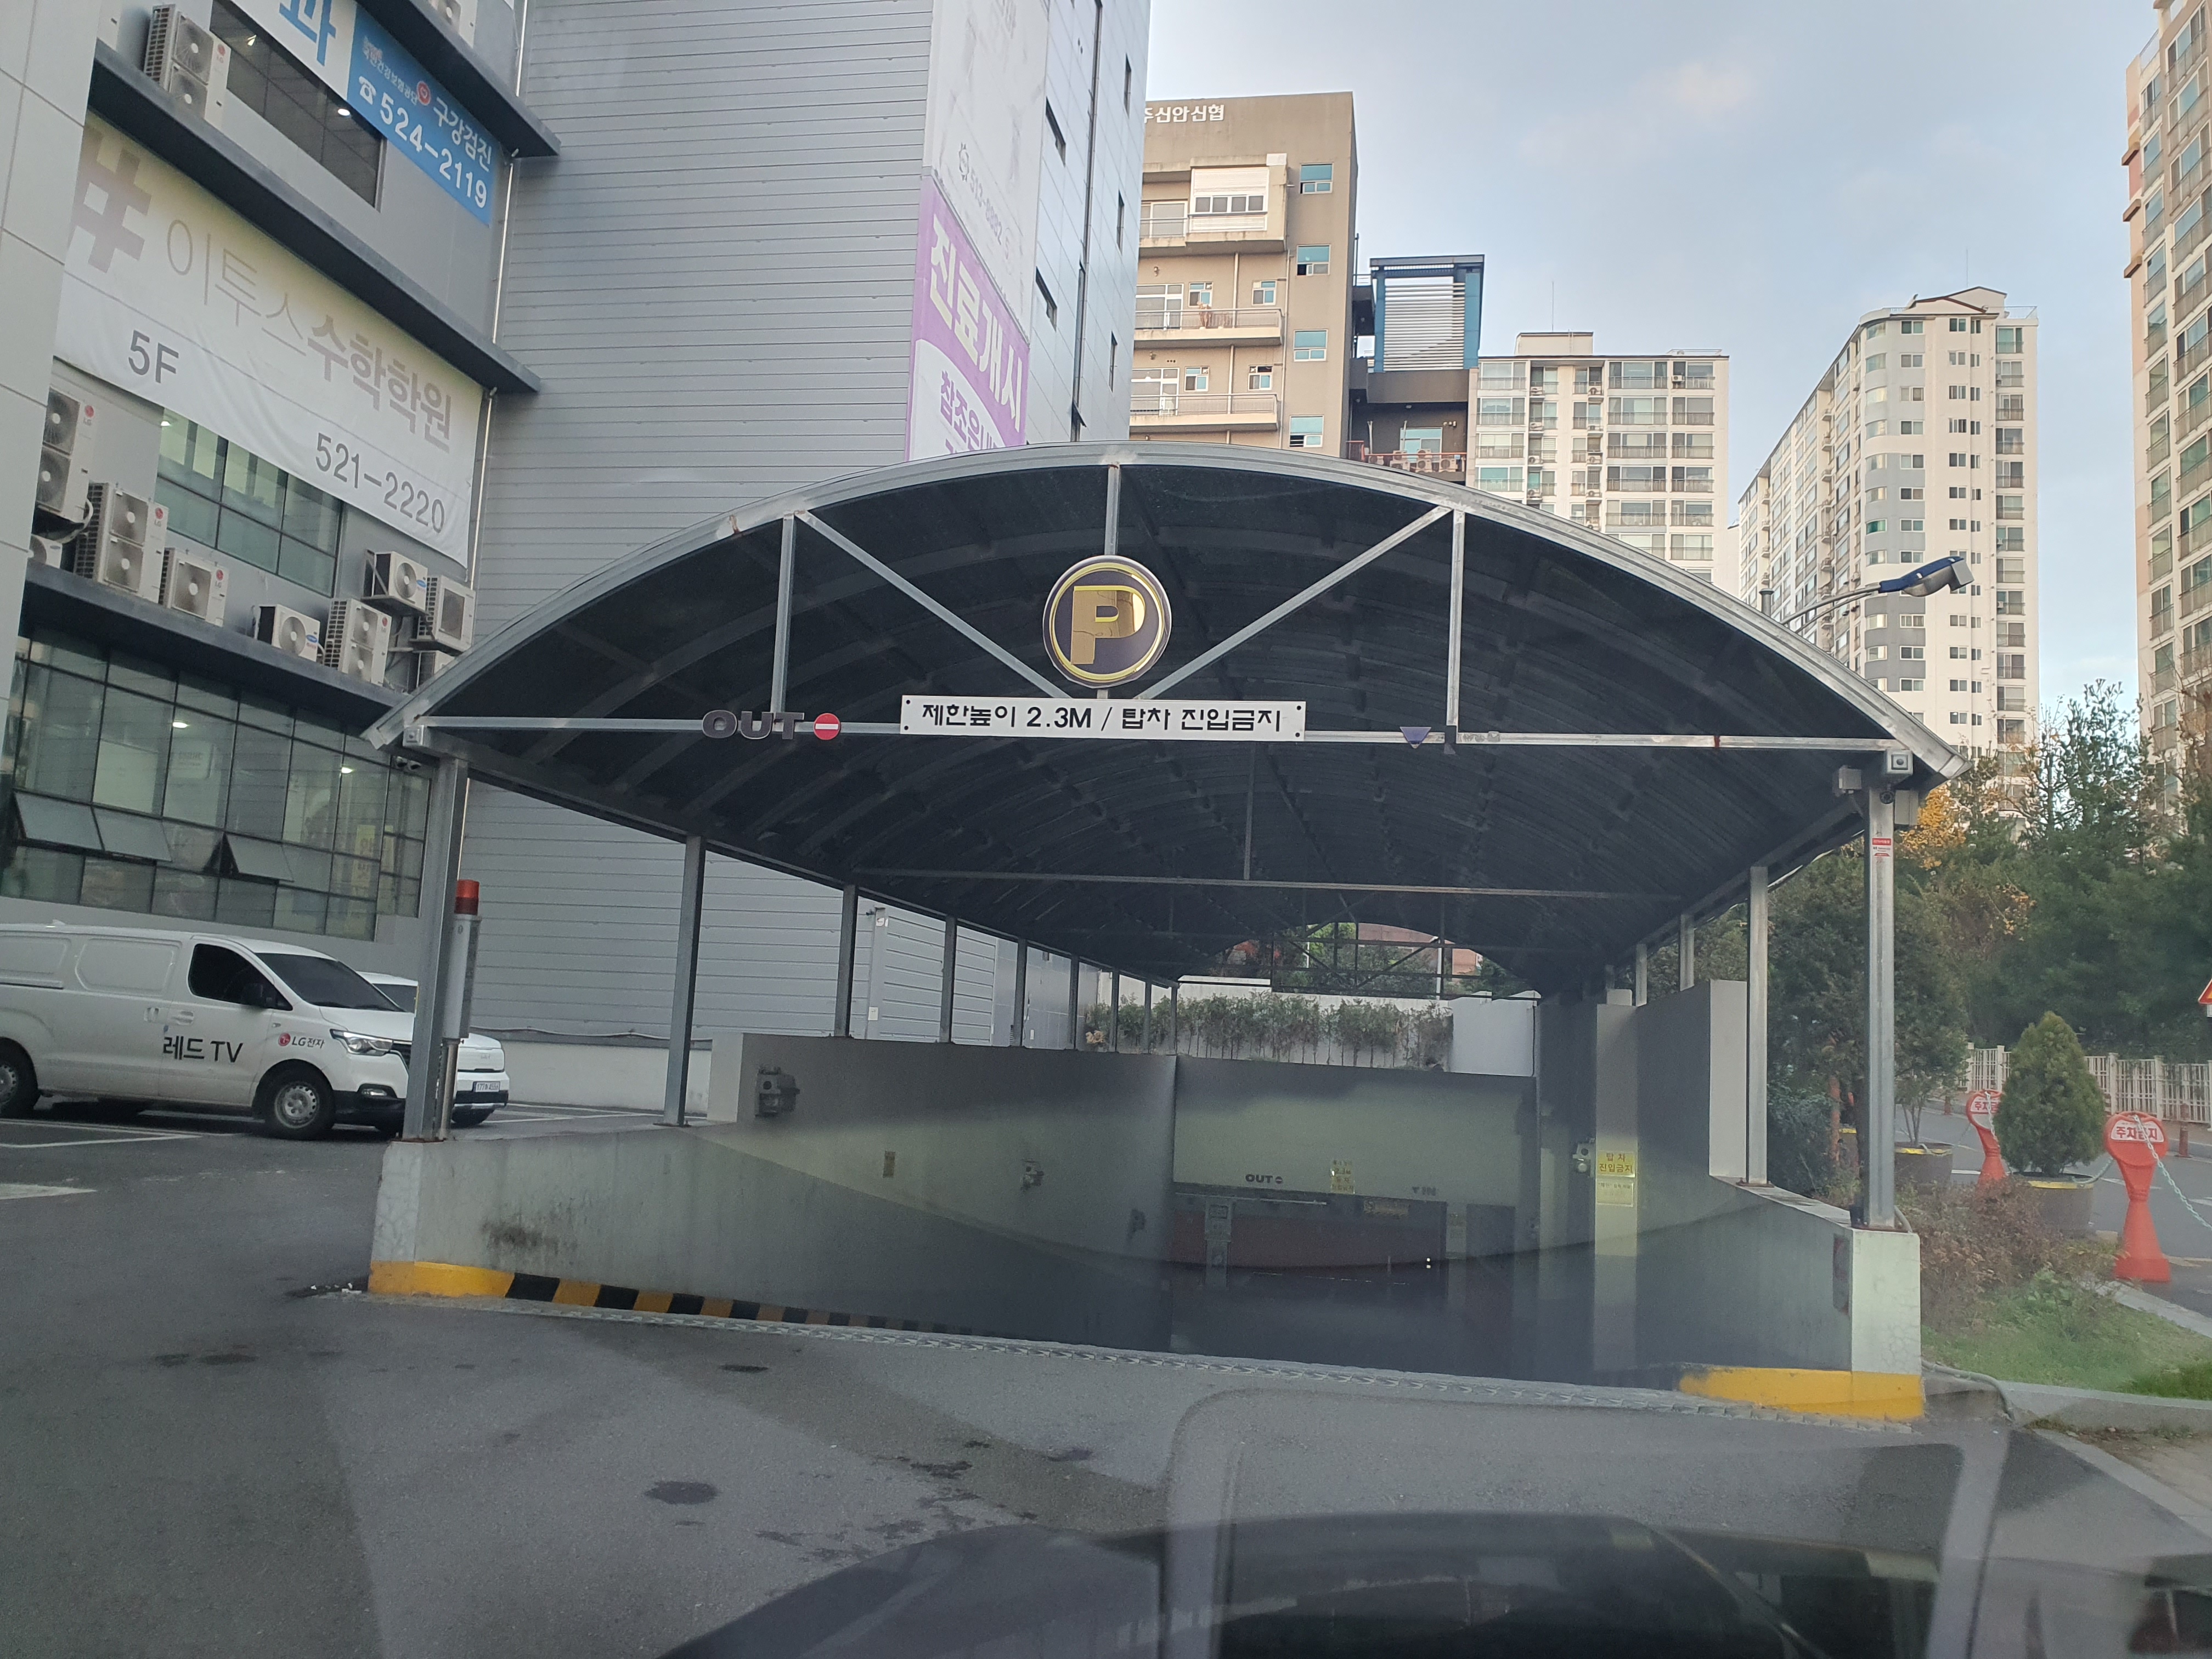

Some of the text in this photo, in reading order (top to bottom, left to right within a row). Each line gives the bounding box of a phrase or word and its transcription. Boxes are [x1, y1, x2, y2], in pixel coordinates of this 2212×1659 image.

[380, 92, 488, 208] 524-2119
[433, 97, 492, 172] 구강검진
[930, 213, 1023, 433] 진료개시
[128, 330, 179, 384] 5F
[315, 432, 445, 534] 521-2220
[1070, 585, 1146, 665] P
[702, 709, 805, 740] OUT
[922, 703, 1015, 727] 제한높이
[1026, 707, 1091, 729] 2.3M
[1122, 708, 1171, 730] 탑차
[1181, 708, 1280, 732] 진입금지
[163, 1035, 244, 1063] 레드 TV
[291, 1036, 325, 1049] LG전자
[1245, 1173, 1273, 1183] OUT
[1599, 1163, 1633, 1173] 진입금지
